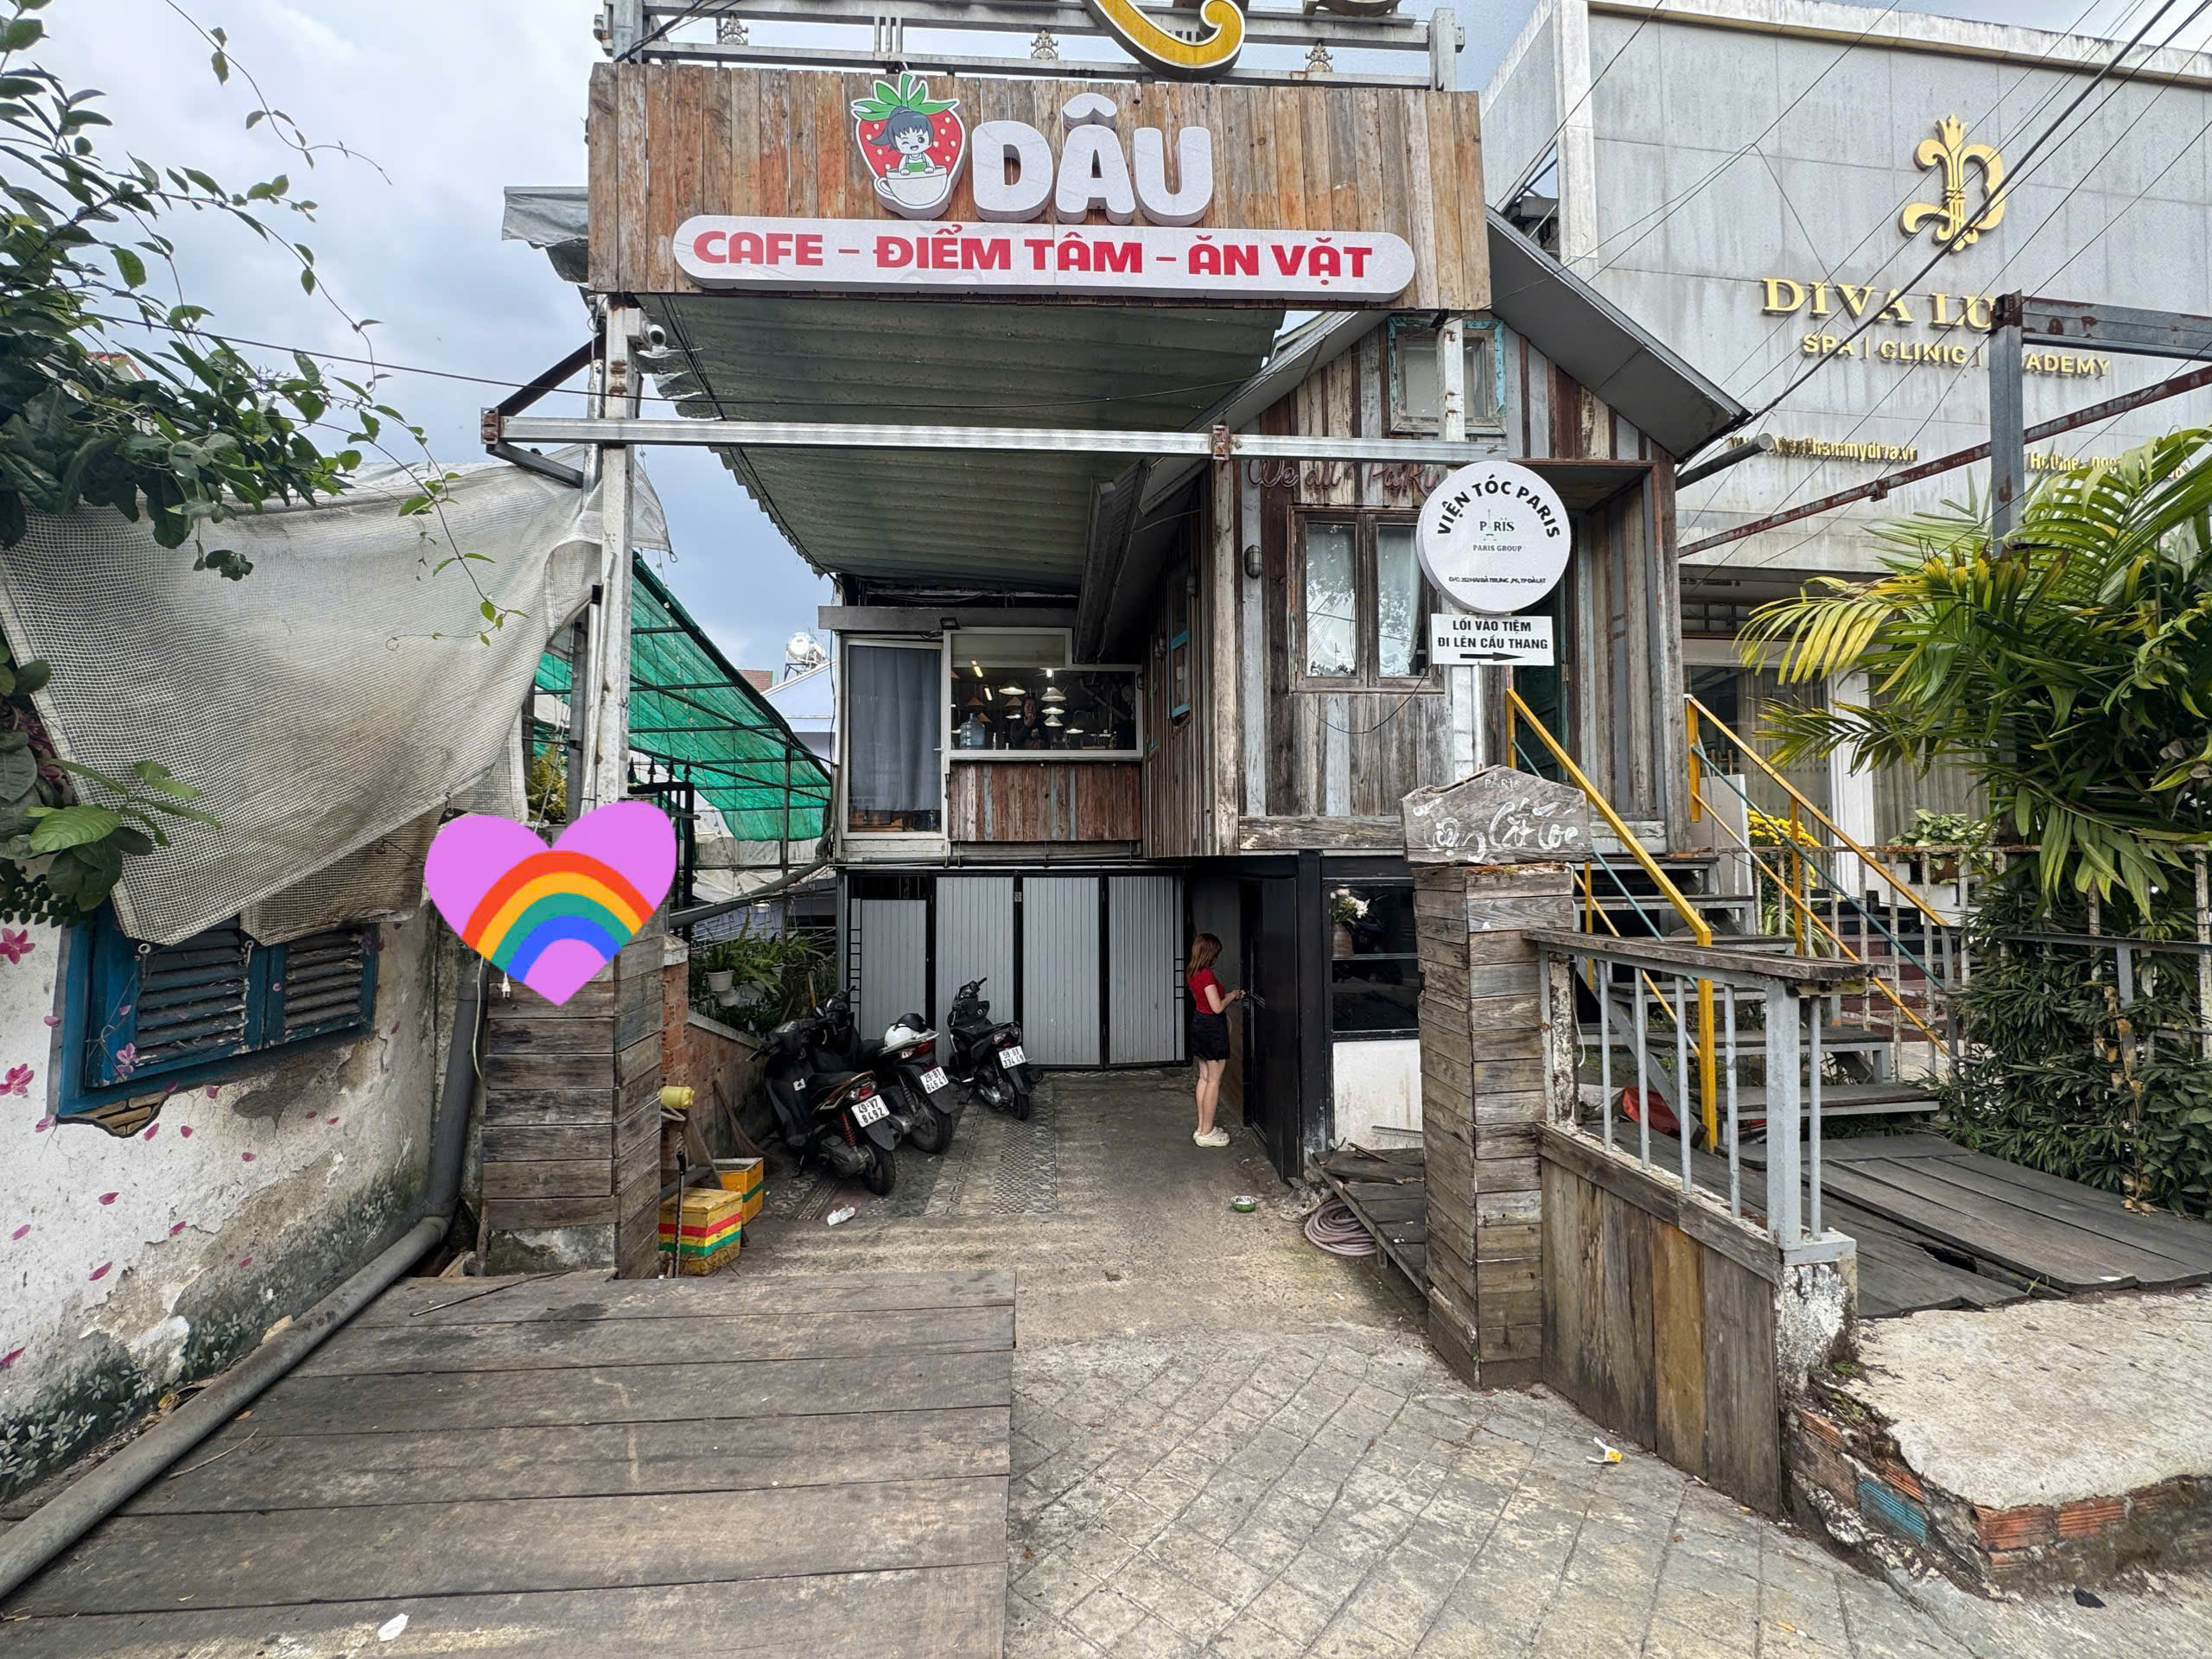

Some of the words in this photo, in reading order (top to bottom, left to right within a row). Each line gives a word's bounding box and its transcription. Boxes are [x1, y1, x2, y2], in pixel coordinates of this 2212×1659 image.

[971, 92, 1213, 226] DÂU
[693, 231, 823, 266] CAFE
[873, 224, 1012, 270] ĐIỂM
[1024, 232, 1142, 273] TÂM
[1188, 234, 1259, 276] ĂN
[1270, 237, 1373, 286] VẶT
[1762, 277, 1915, 324] DIVA
[1802, 334, 1854, 356] SPA
[1880, 340, 1968, 365] CLINIC
[2022, 353, 2111, 375] ADEMY
[1437, 491, 1471, 535] VIỆN
[1471, 474, 1512, 498] TÓC
[1516, 486, 1560, 538] PARIS
[1438, 637, 1450, 647] ĐI
[1453, 635, 1476, 648] LÊN
[1508, 639, 1548, 649] THANG
[1452, 617, 1471, 631] LỐI
[1475, 619, 1498, 632] VÀO
[1502, 620, 1531, 633] TIỆM
